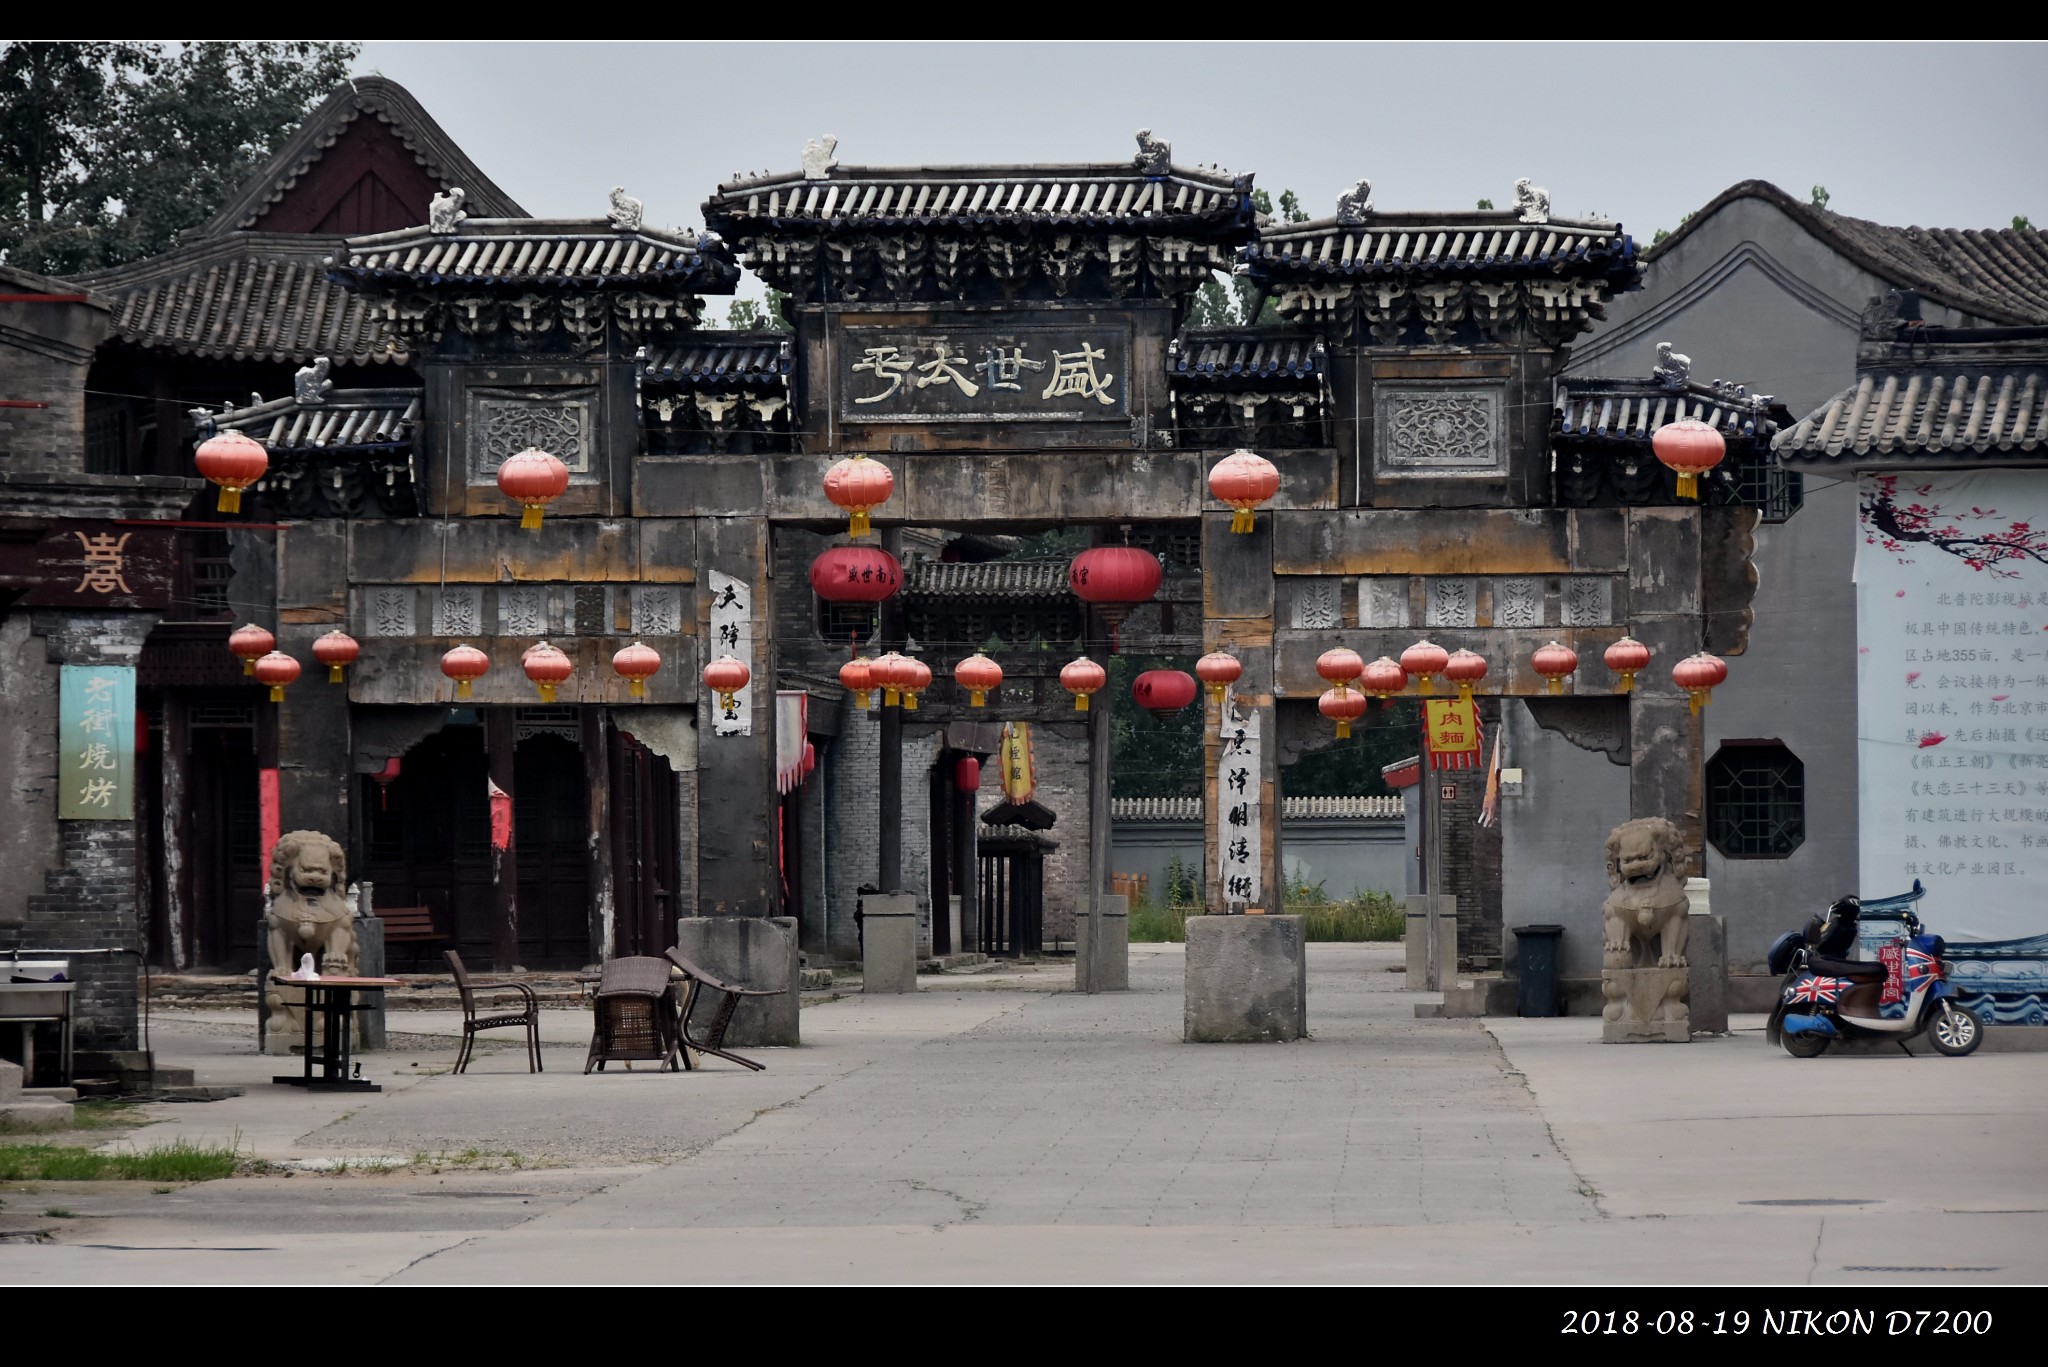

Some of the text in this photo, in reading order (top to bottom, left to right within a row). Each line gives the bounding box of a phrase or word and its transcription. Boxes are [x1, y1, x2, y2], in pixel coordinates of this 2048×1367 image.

[1906, 648, 2048, 662] 区占地355亩，是一
